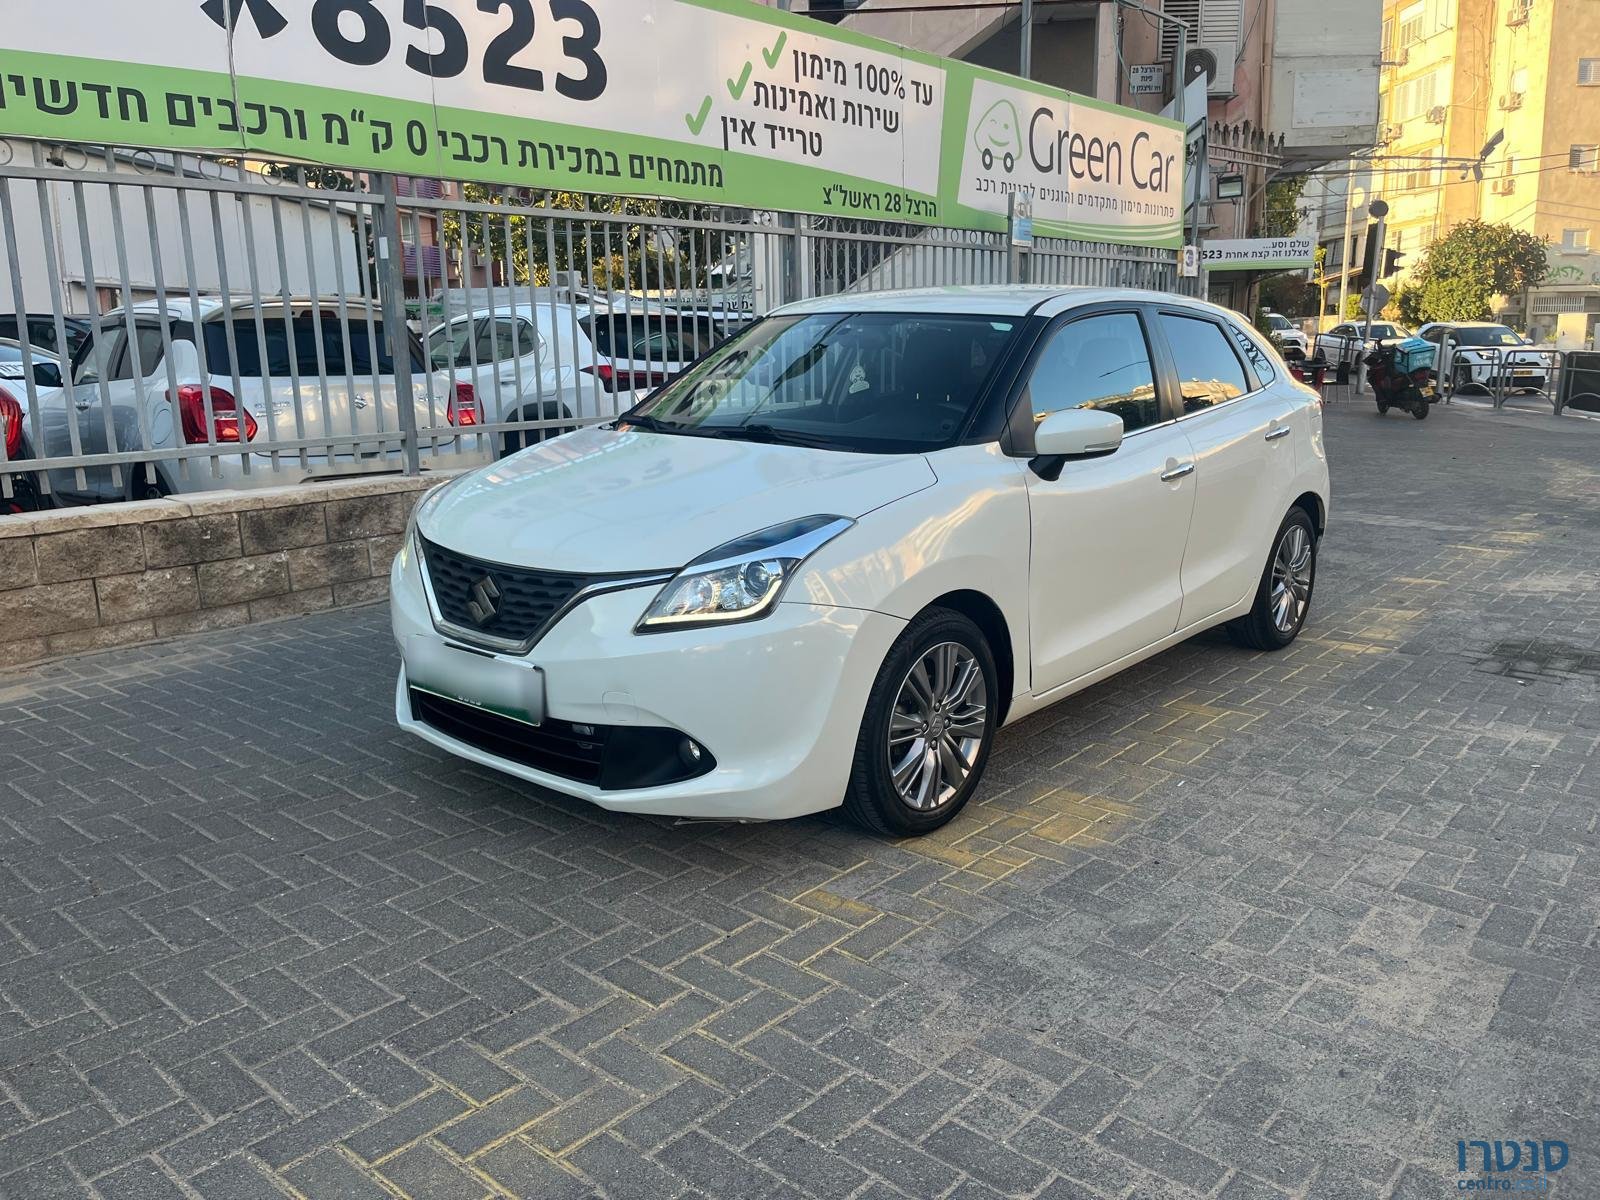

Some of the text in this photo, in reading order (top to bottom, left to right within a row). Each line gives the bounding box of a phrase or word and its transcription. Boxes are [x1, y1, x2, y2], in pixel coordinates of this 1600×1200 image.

[793, 49, 933, 106] עד 100% מימון
[0, 73, 149, 123] חדשי
[753, 80, 899, 133] שירות ואמינות
[165, 92, 307, 140] ורכבים
[406, 119, 428, 156] 0
[437, 130, 508, 165] רכבי
[721, 116, 823, 157] טרייד אין
[518, 139, 621, 177] במכירת
[1029, 107, 1175, 193] Green Car
[629, 153, 724, 188] מתמחים
[975, 177, 996, 193] רכב
[1040, 187, 1074, 204] והוגנים
[885, 192, 902, 213] 28
[905, 194, 937, 217] הרצל
[1077, 193, 1118, 212] מתקדמים
[1120, 199, 1142, 214] מימון
[1144, 203, 1174, 218] פתרונות
[1225, 250, 1249, 259] אחרת
[1252, 249, 1270, 259] קצת
[1285, 248, 1309, 257] אצלנו
[1290, 240, 1310, 249] שלם
